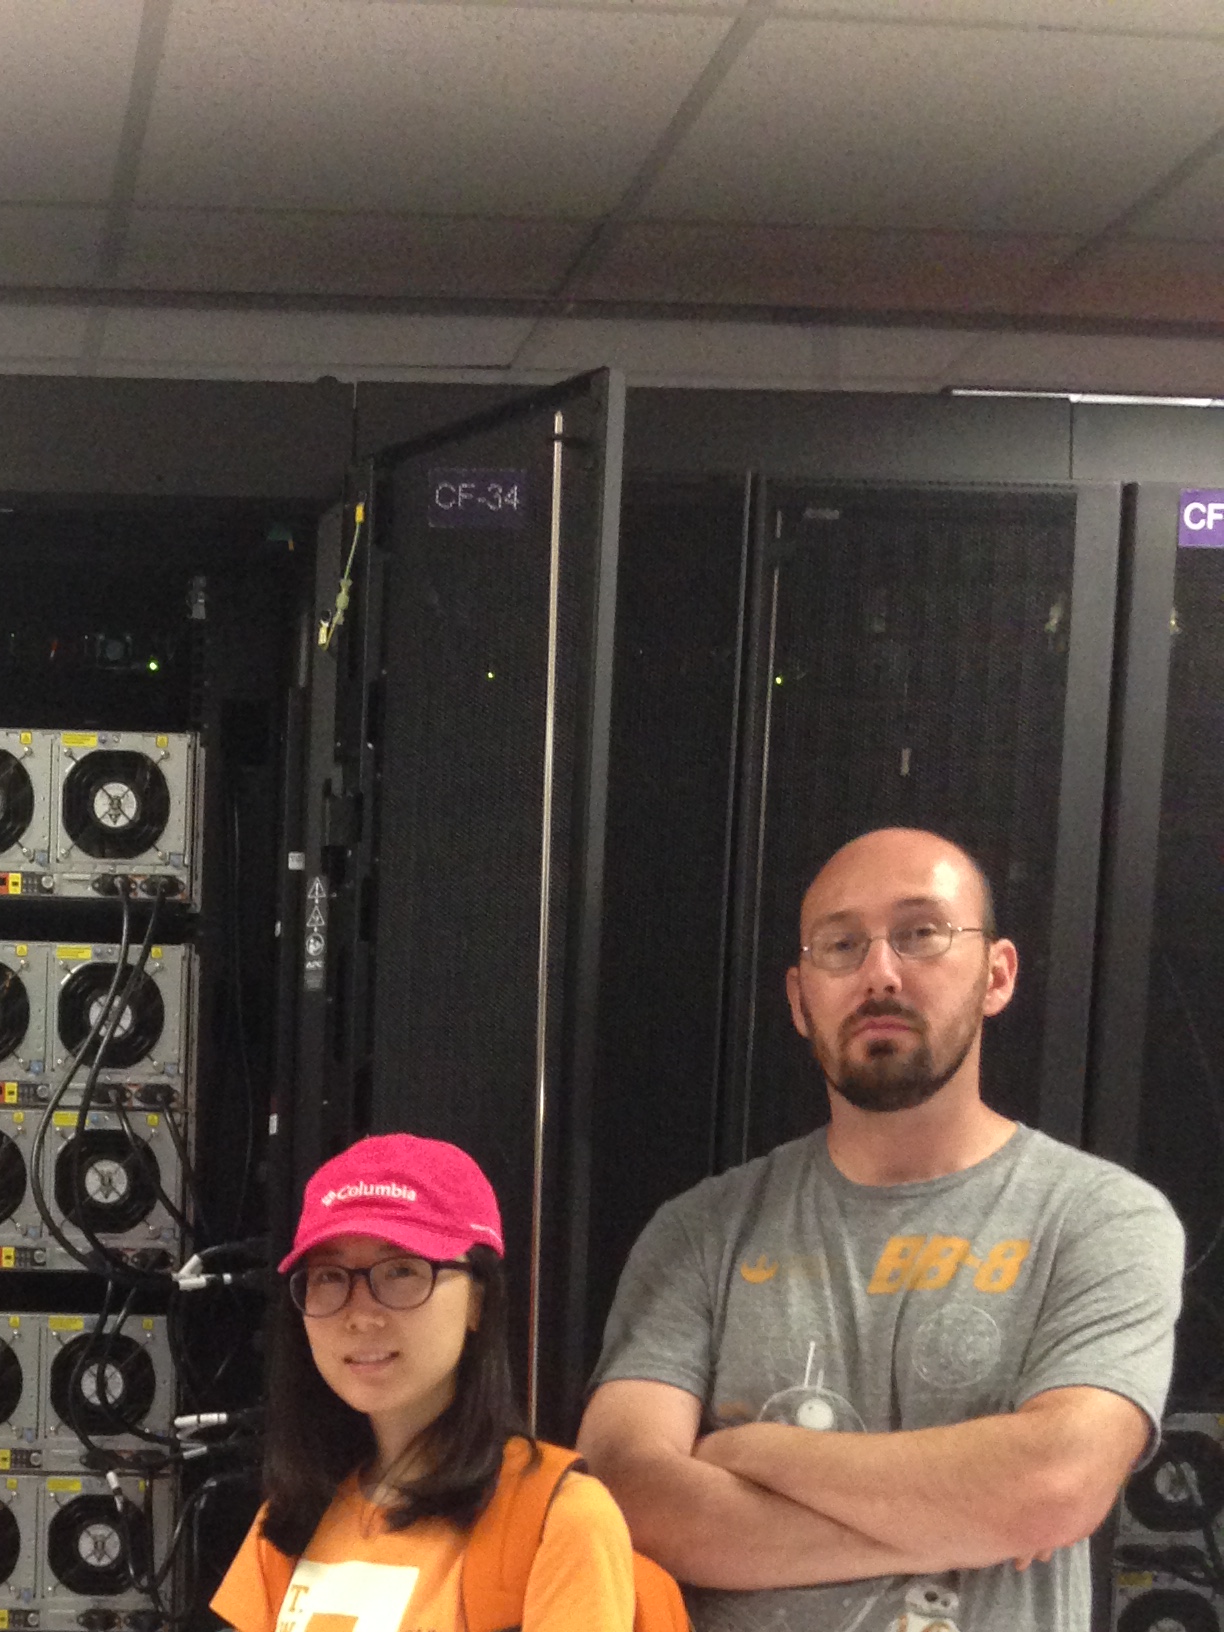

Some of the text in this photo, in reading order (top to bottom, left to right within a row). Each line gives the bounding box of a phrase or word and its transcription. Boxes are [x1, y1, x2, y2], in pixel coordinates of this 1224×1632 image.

[435, 482, 520, 511] CF-34
[1183, 502, 1224, 531] CF
[337, 1181, 417, 1202] Columbia
[867, 1234, 1031, 1294] BB-8
